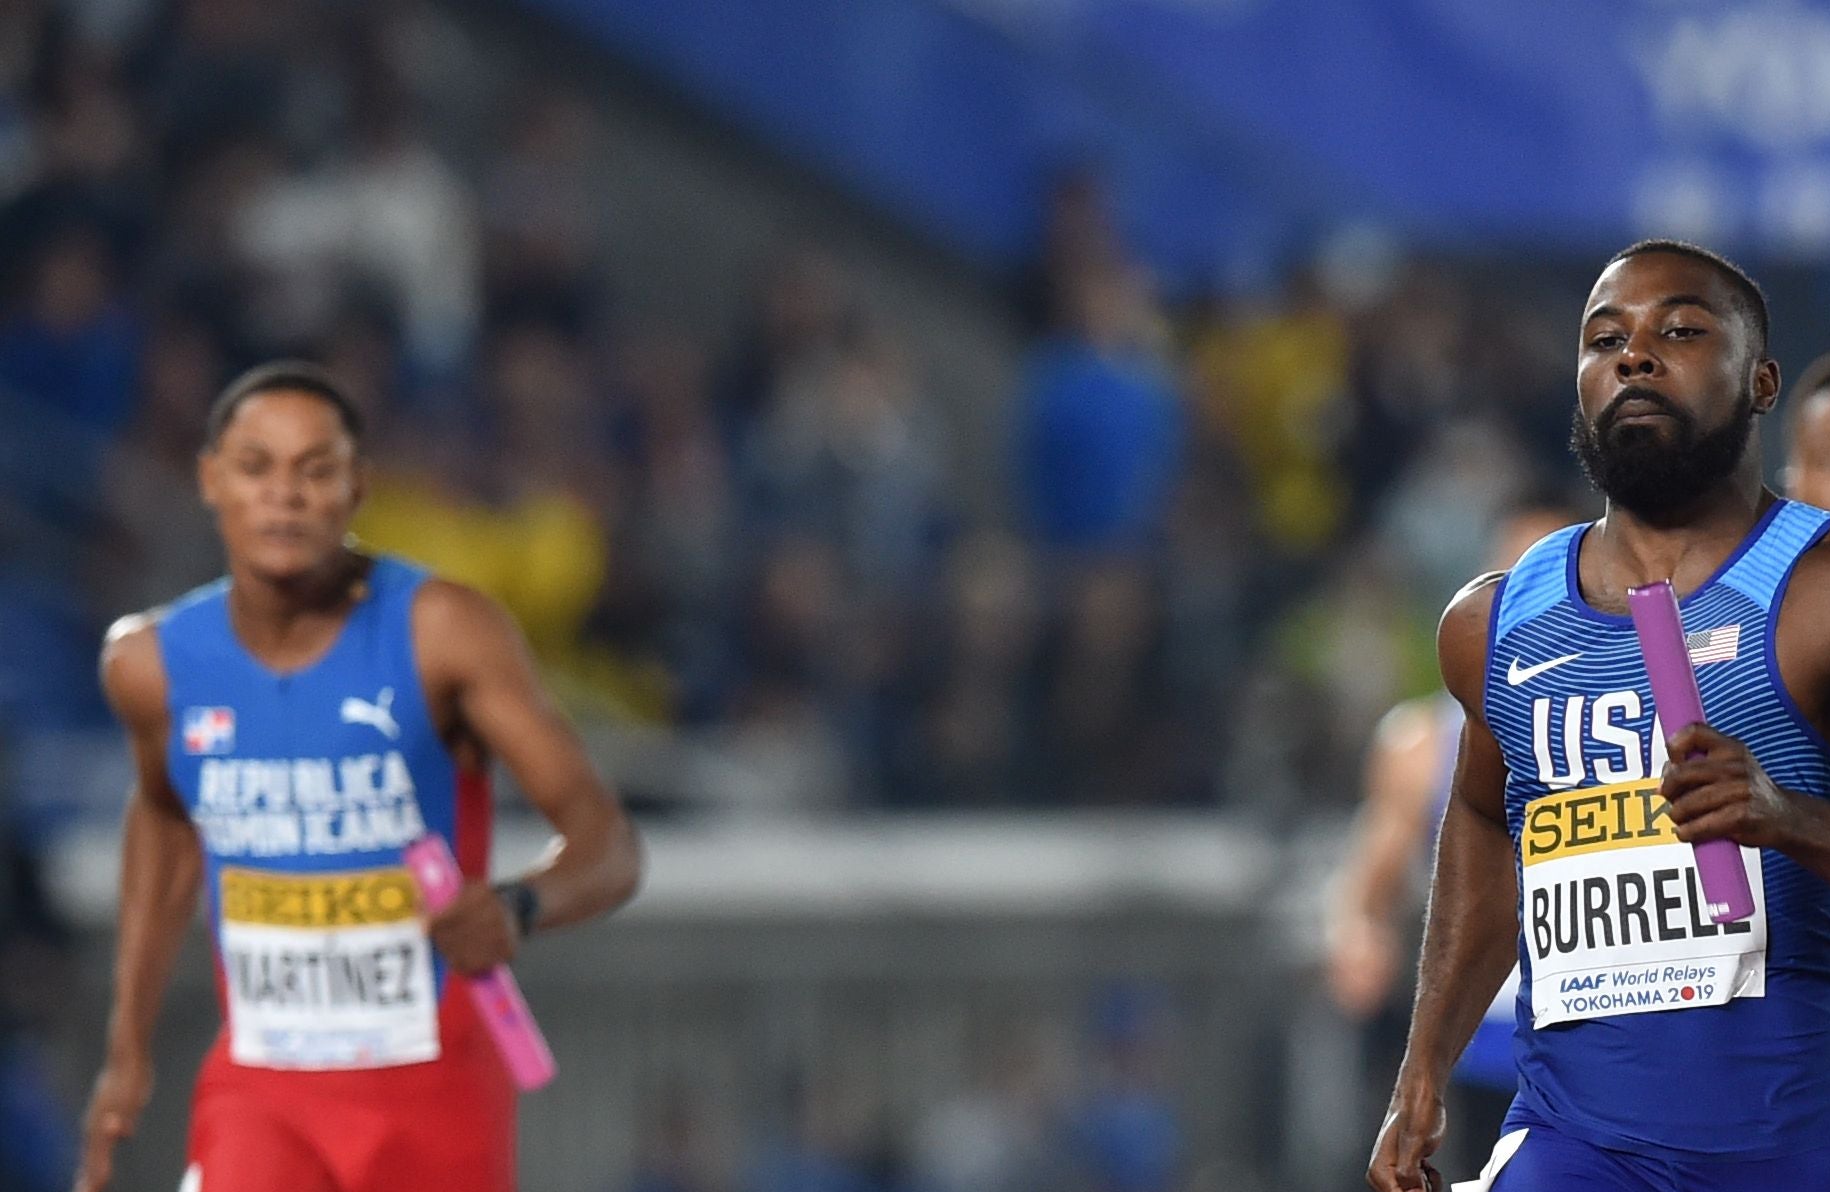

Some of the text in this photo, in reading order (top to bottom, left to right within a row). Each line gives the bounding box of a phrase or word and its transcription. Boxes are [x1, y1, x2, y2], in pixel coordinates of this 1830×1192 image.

[1529, 788, 1679, 856] SEIK
[224, 877, 415, 924] SEIKO
[1560, 965, 1716, 993] IAAF World Relays
[1561, 989, 1664, 1013] YOKOHAMA
